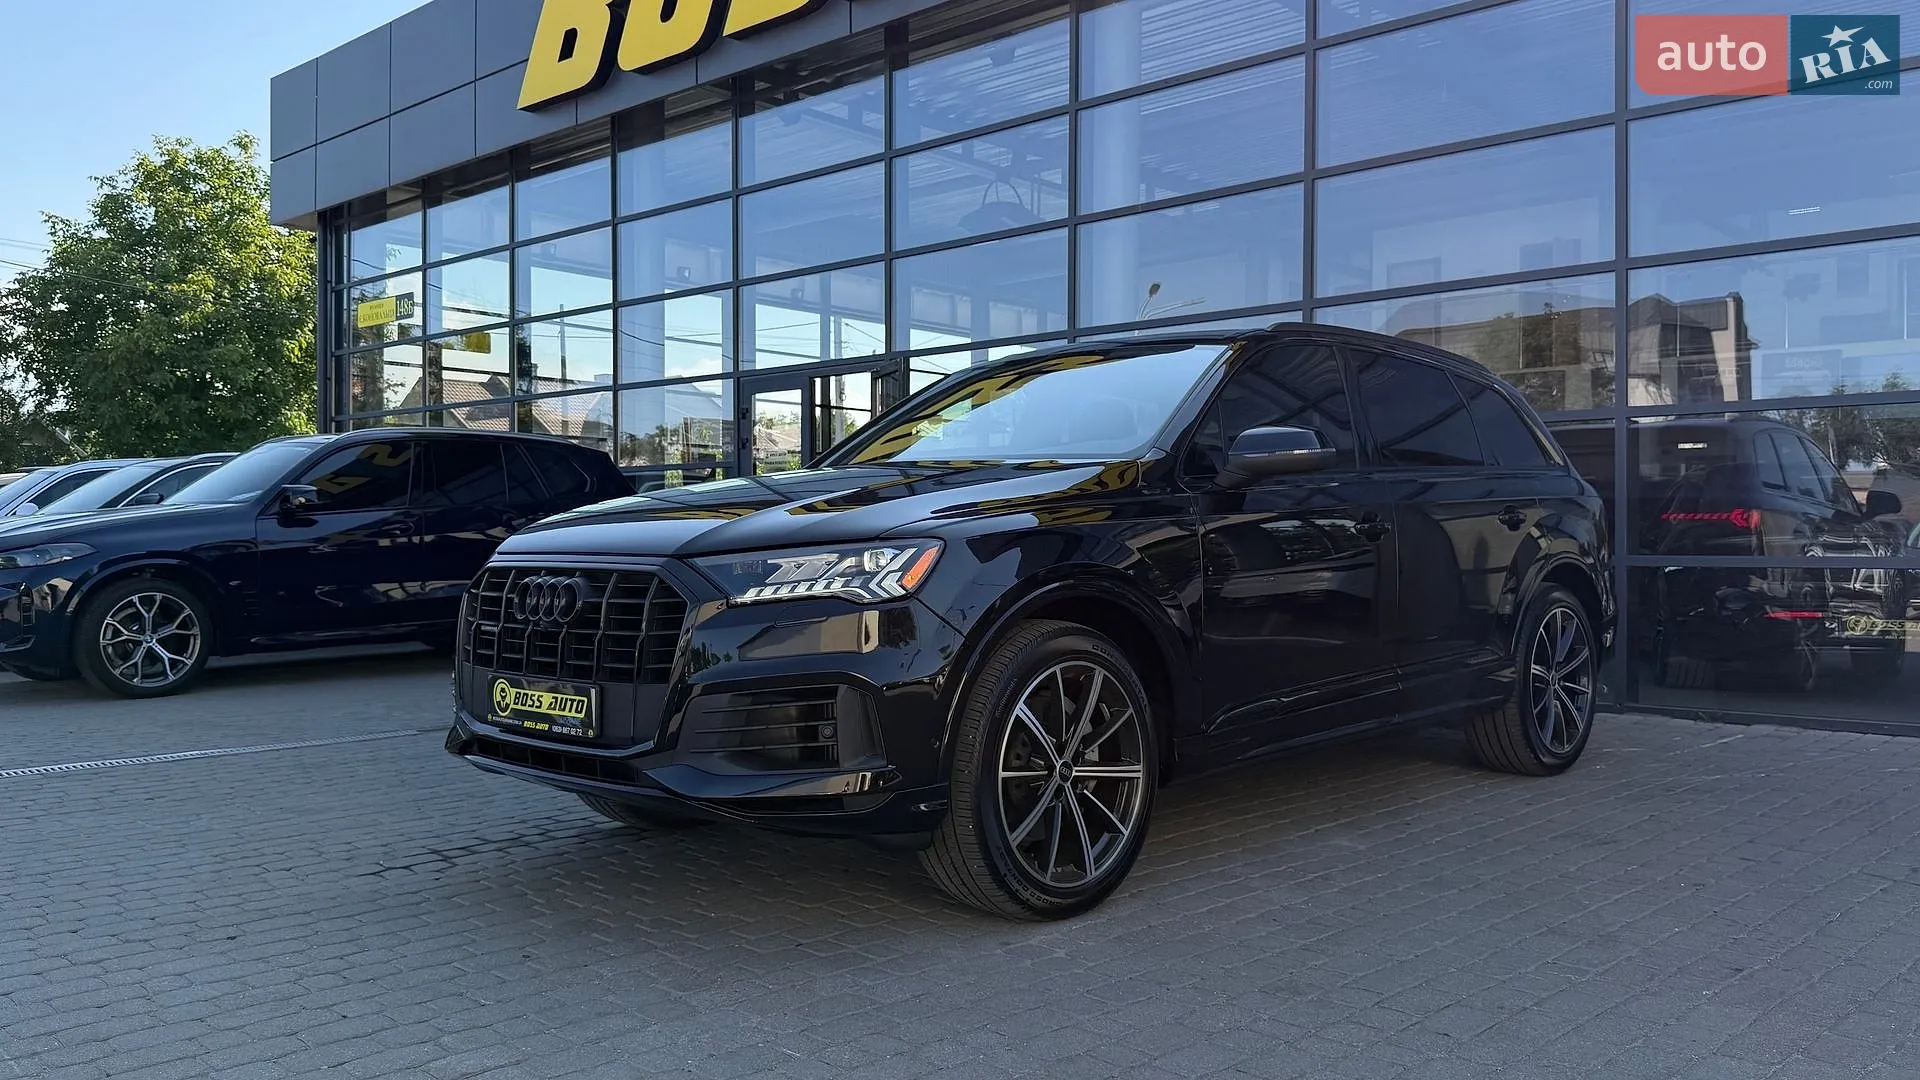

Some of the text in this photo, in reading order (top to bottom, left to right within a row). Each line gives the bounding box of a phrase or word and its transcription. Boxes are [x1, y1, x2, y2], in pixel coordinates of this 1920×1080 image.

[513, 691, 585, 715] BOSS AUTO
[523, 720, 536, 729] BOSS
[535, 722, 550, 731] AUTO
